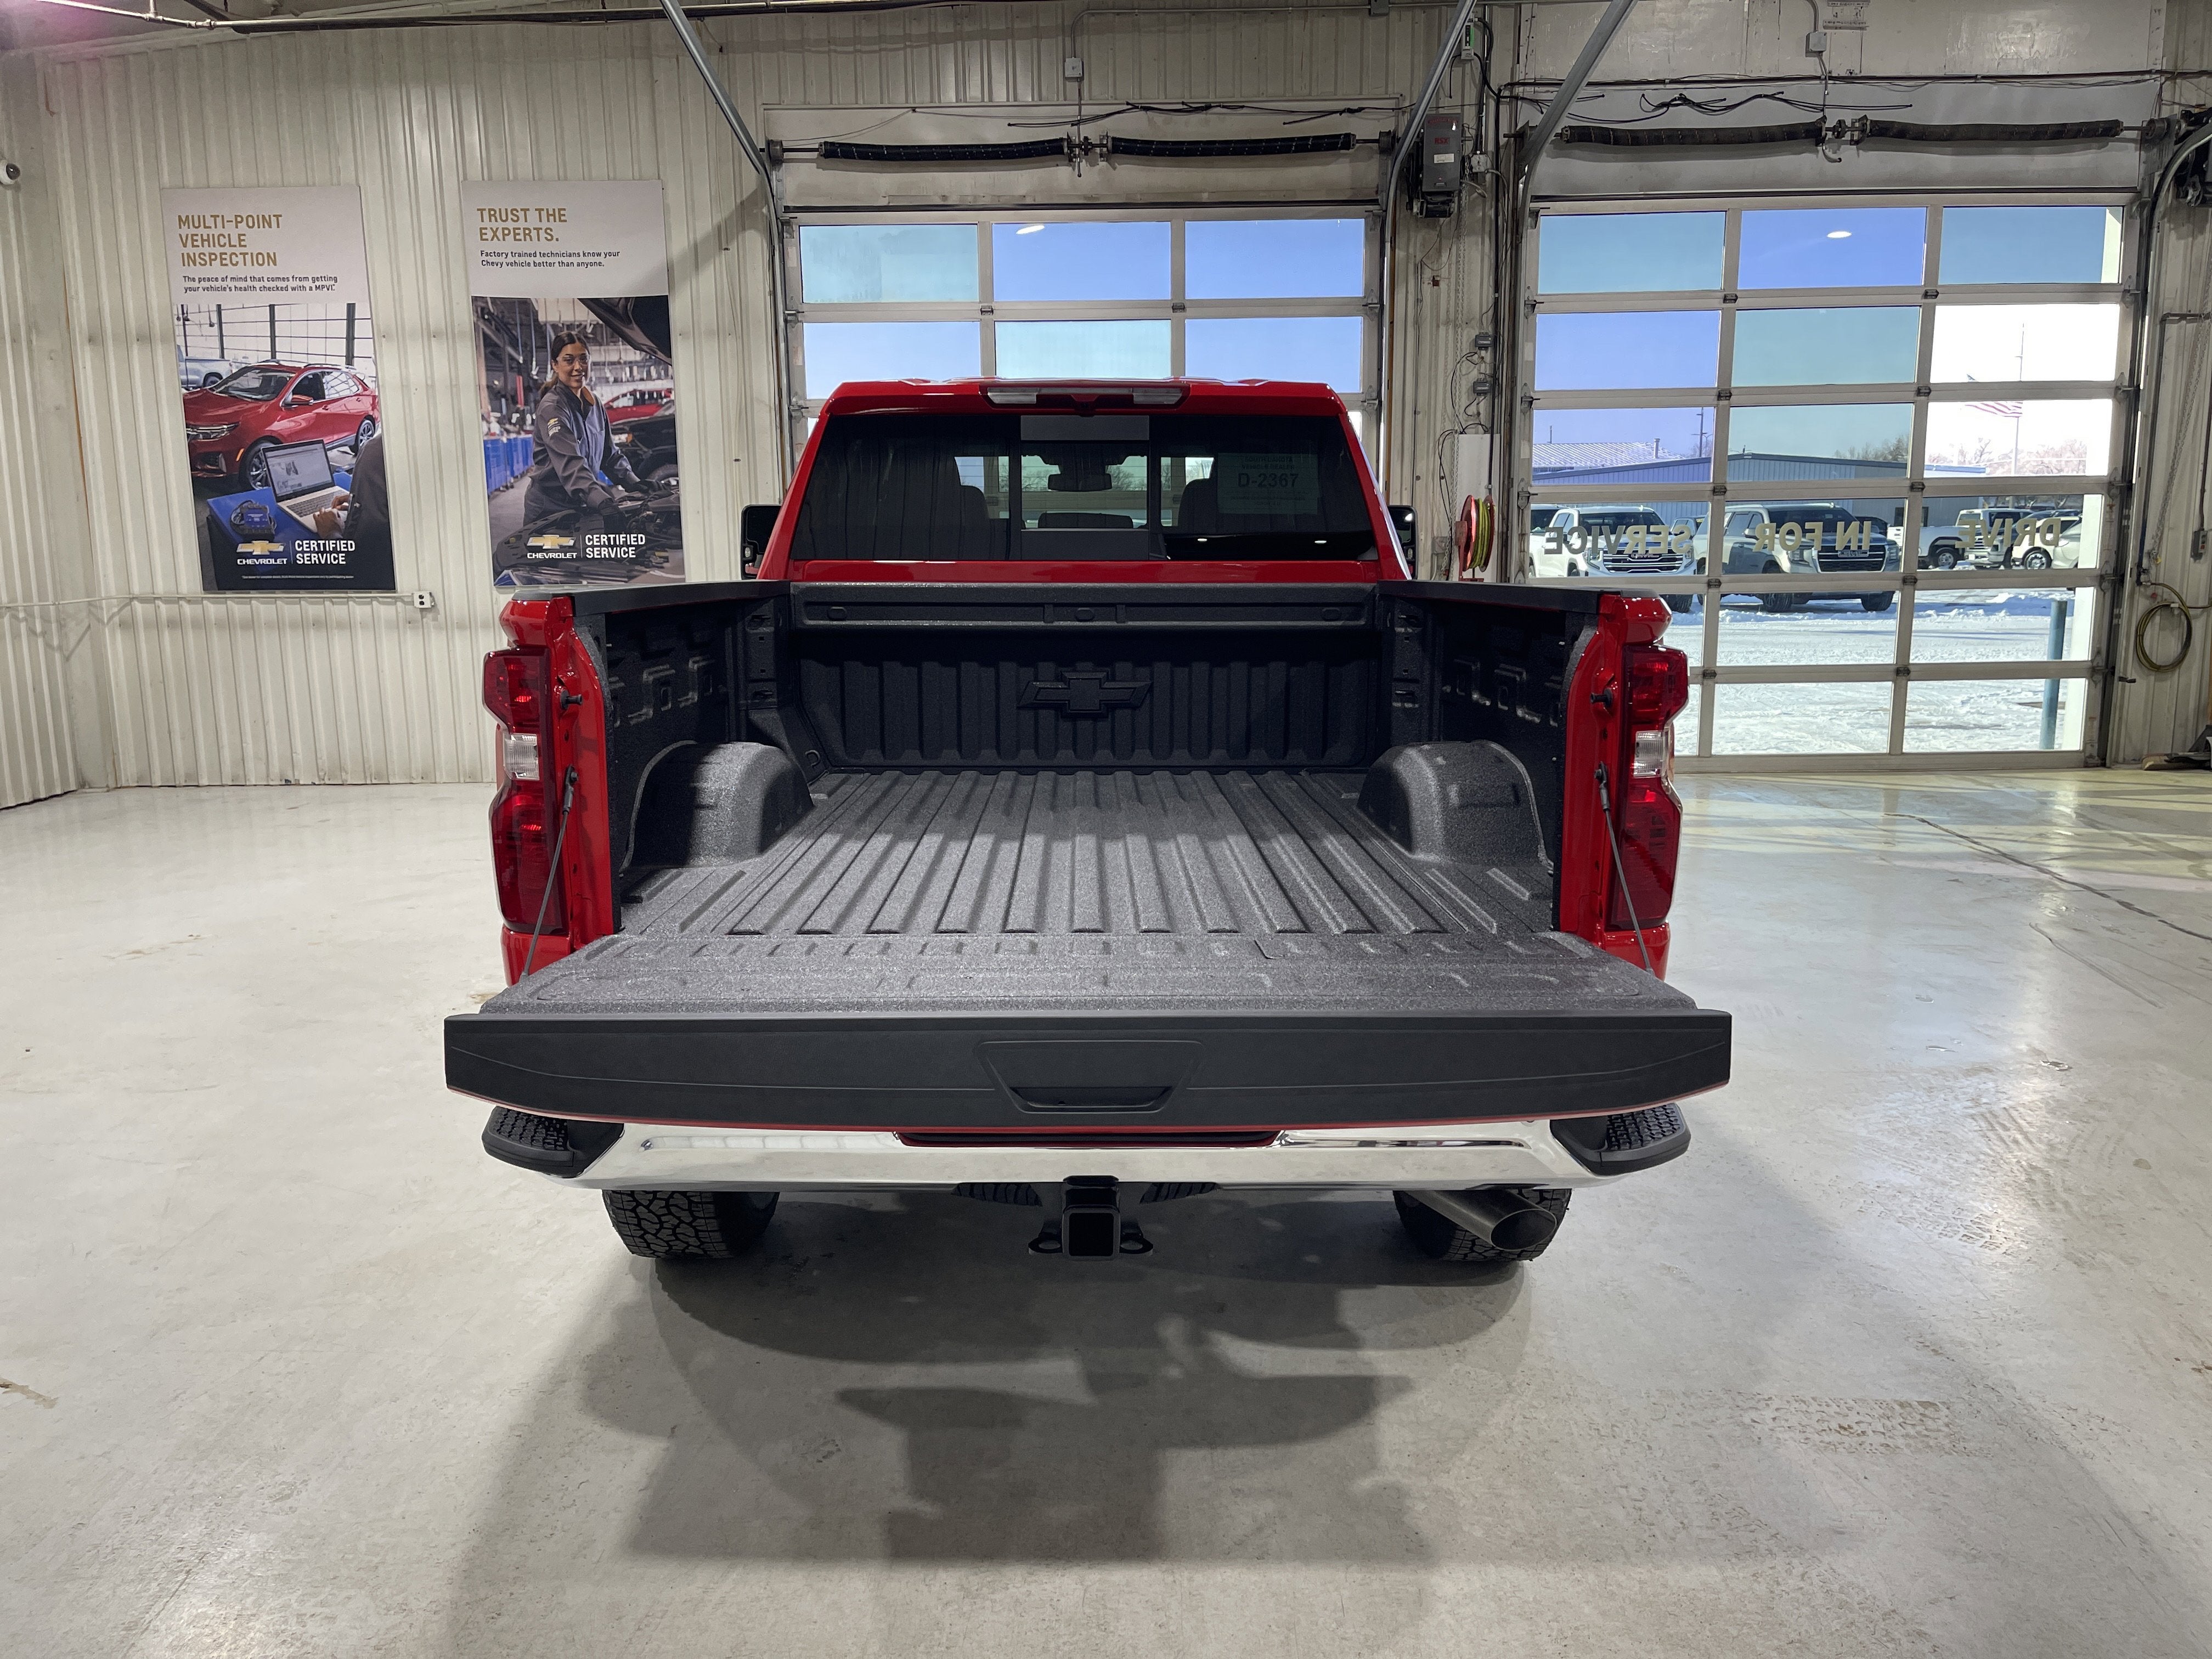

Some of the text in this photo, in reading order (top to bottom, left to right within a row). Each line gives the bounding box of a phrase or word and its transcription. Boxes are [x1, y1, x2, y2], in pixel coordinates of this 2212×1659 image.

[178, 214, 283, 229] MULTI-POINT
[477, 208, 567, 223] TRUST THE
[479, 227, 560, 242] EXPERTS.
[179, 233, 247, 249] VEHICLE
[181, 252, 278, 267] INSPECTION
[481, 250, 509, 259] Factory
[603, 251, 620, 259] your
[481, 259, 504, 268] Chevy
[311, 275, 338, 284] getting
[1238, 472, 1299, 488] D-2367
[295, 540, 356, 552] CERTIFIED
[585, 534, 646, 546] CERTIFIED
[585, 547, 636, 558] SERVICE
[296, 553, 346, 565] SERVICE
